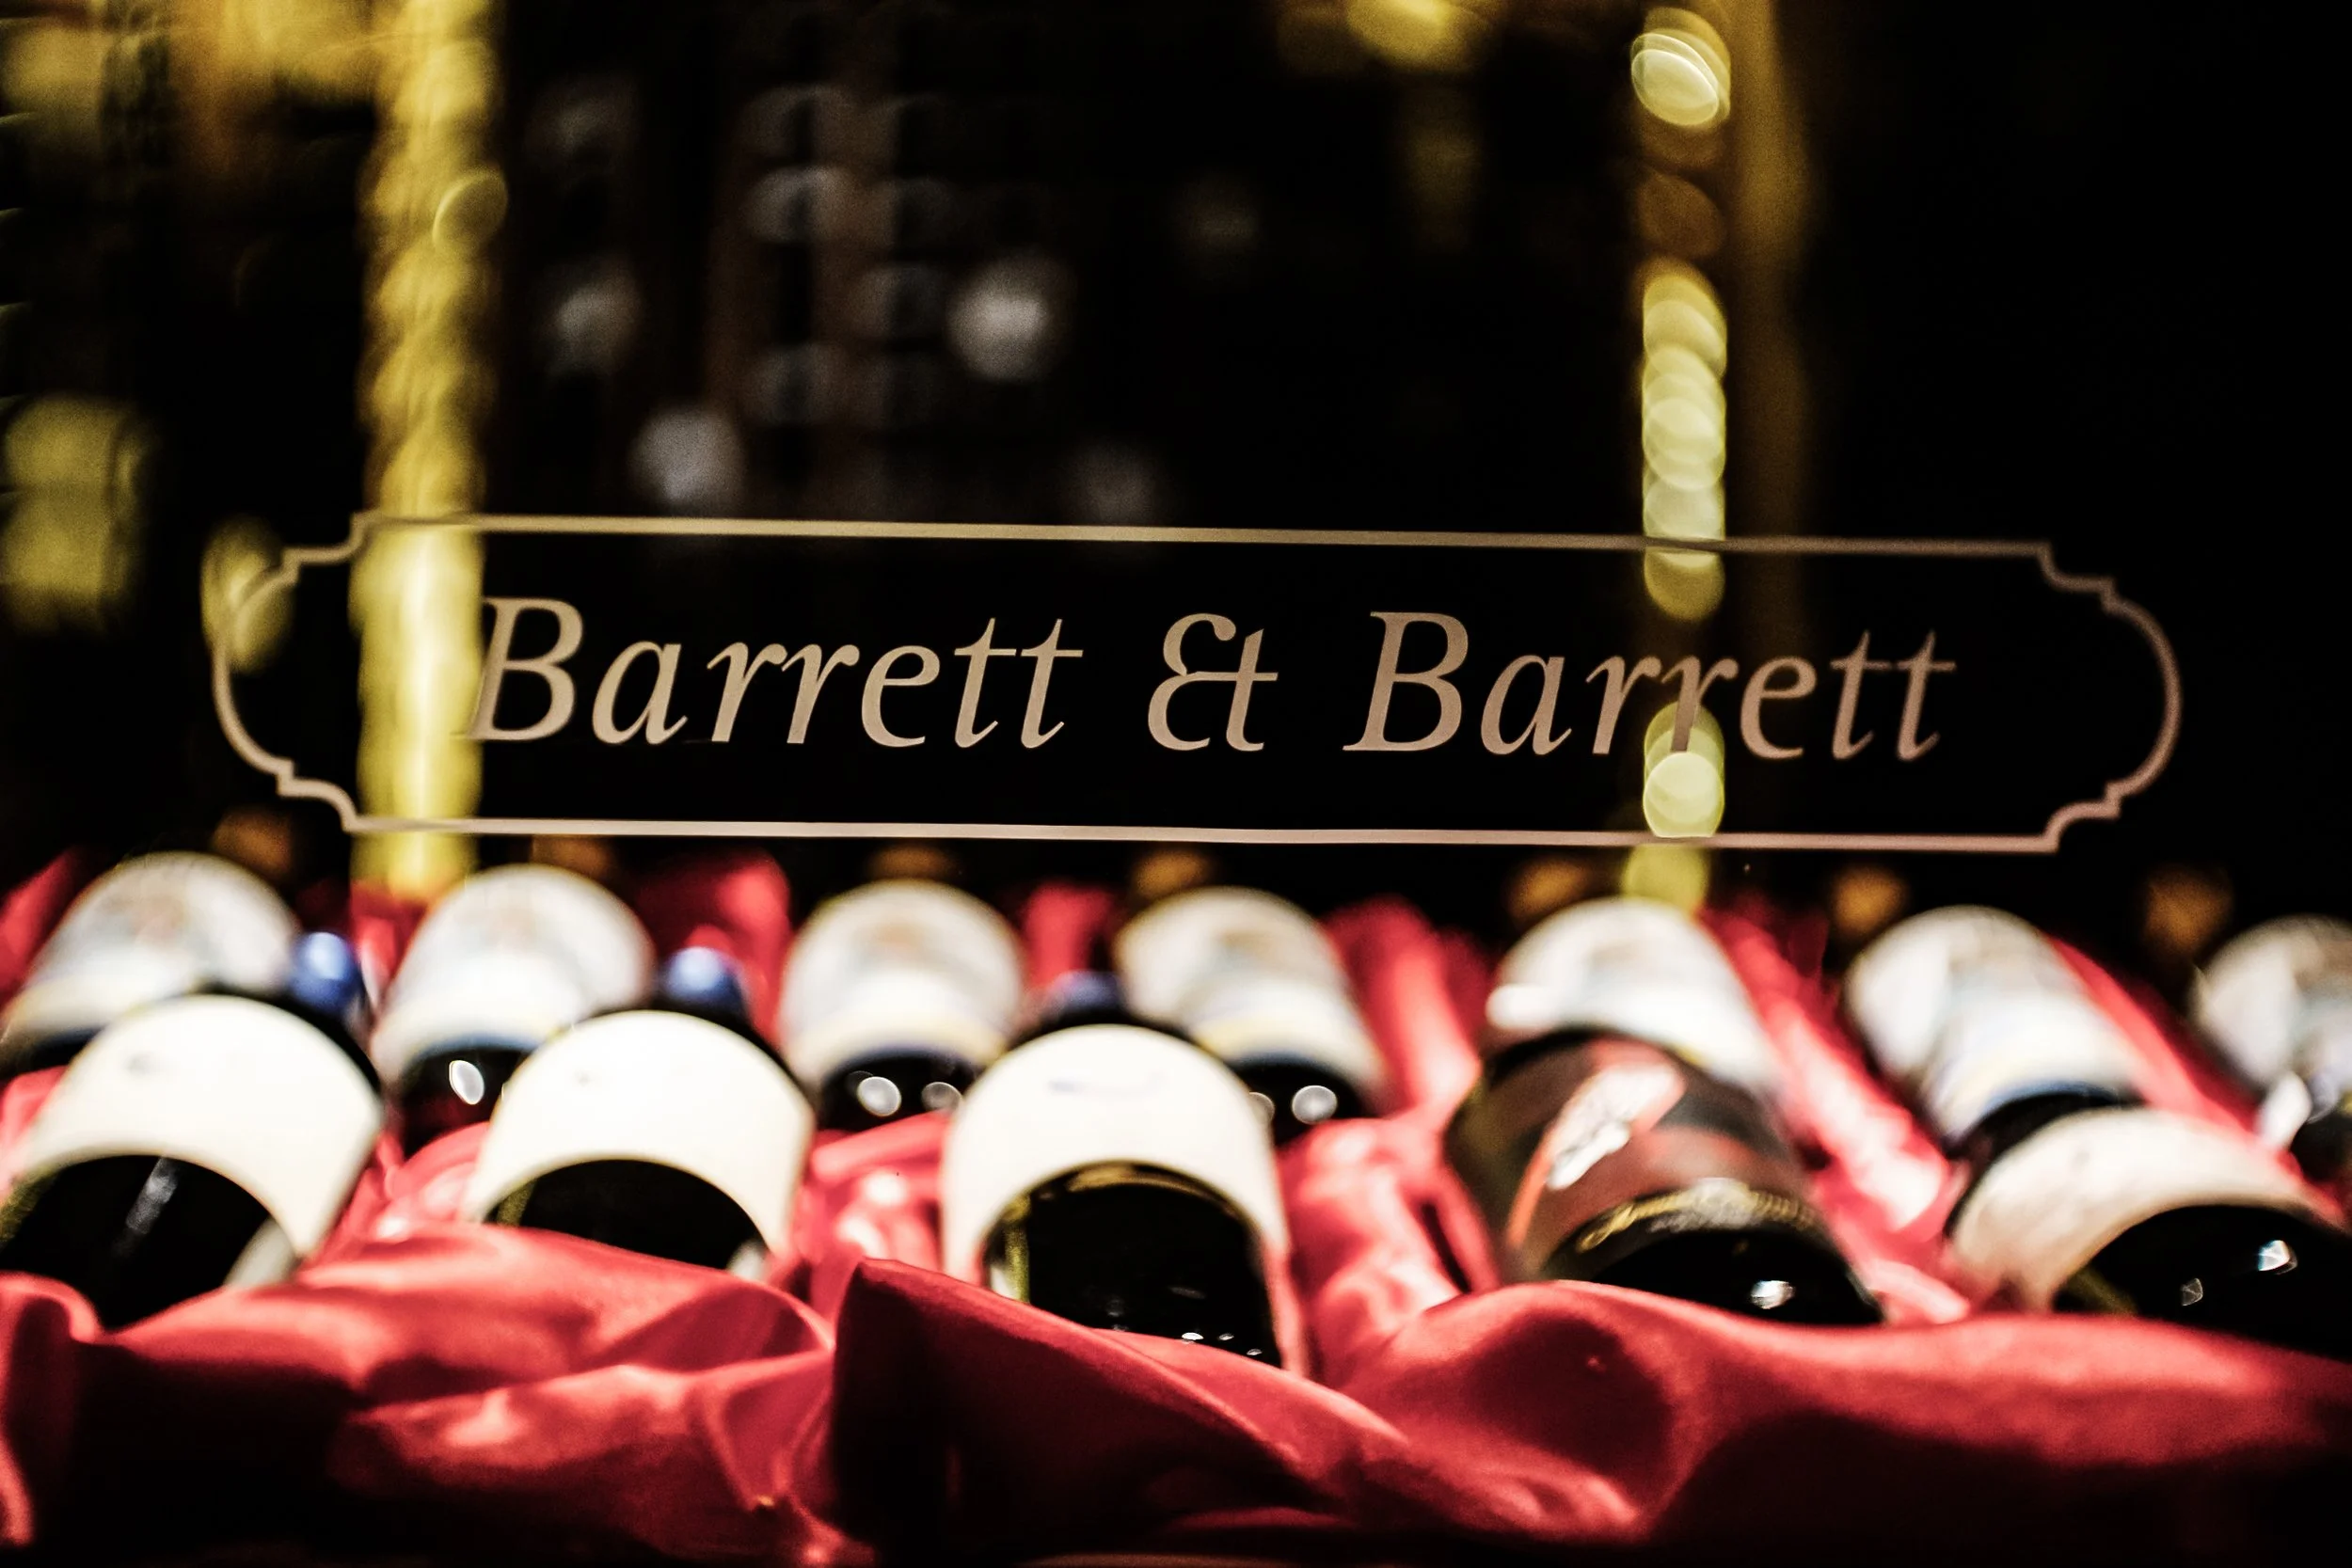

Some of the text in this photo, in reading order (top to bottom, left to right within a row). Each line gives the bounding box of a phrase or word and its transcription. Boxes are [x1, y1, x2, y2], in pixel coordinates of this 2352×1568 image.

[463, 596, 1957, 761] Barrett & Barrett
